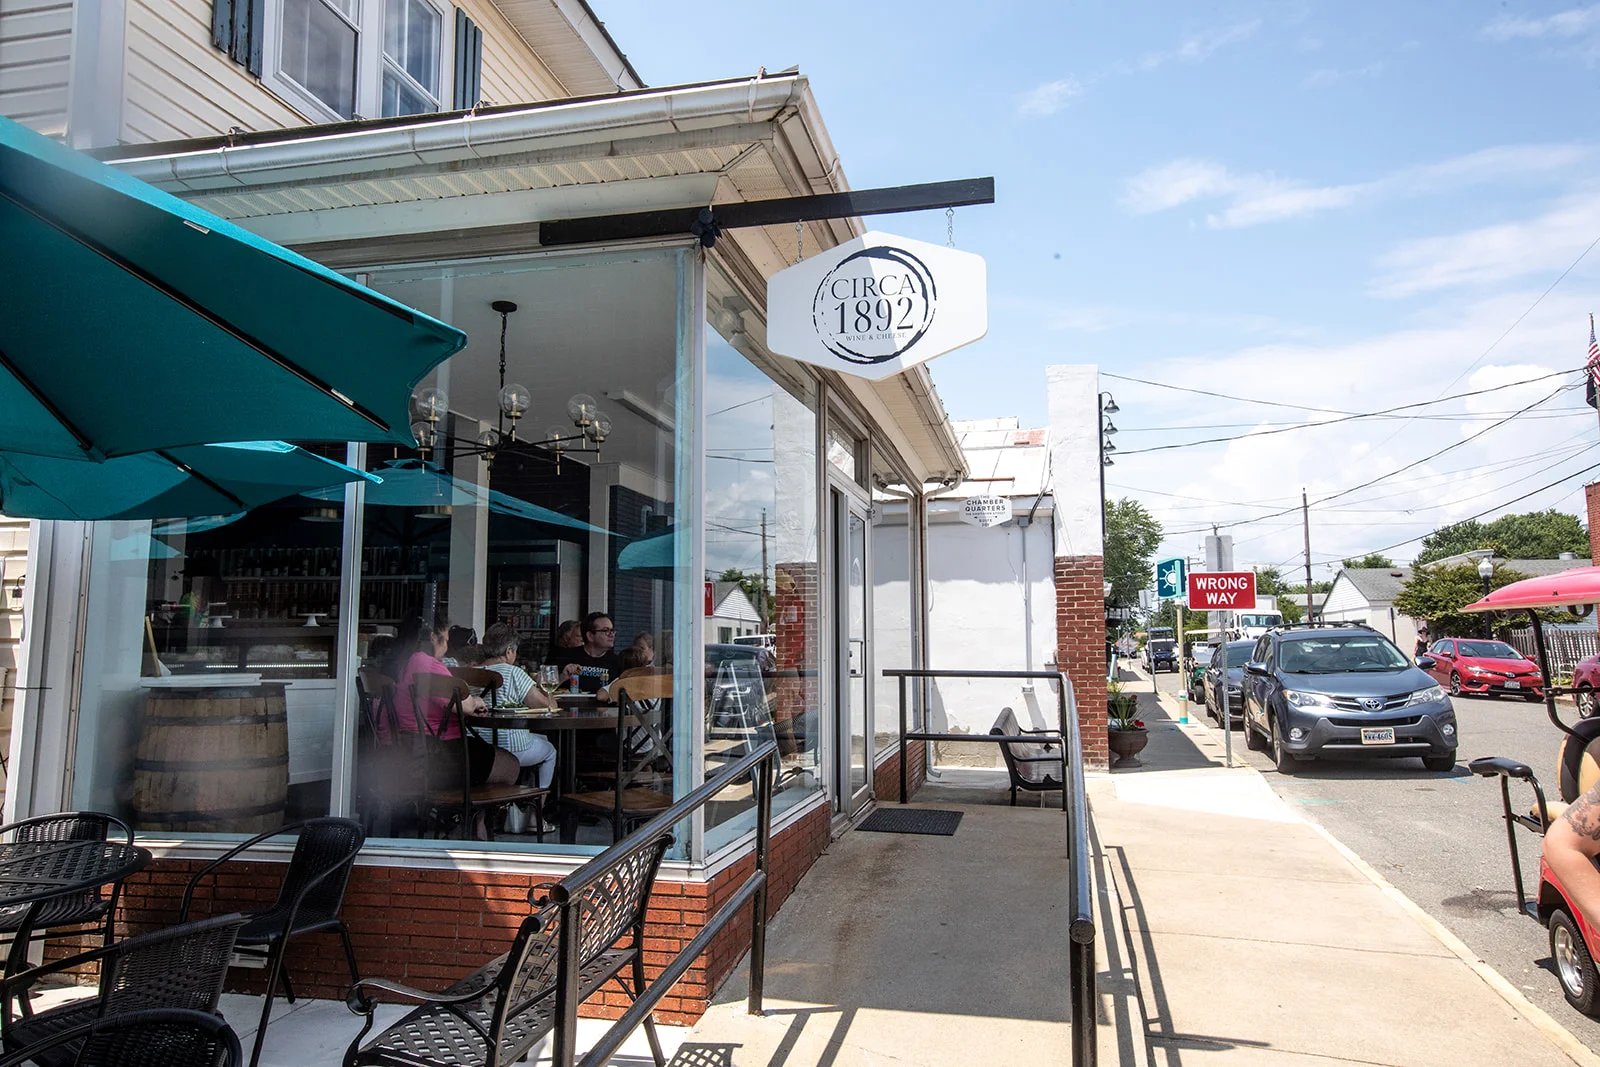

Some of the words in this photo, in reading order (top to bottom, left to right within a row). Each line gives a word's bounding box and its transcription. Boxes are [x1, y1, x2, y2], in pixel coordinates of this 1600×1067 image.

[831, 273, 917, 300] CIRCA
[834, 296, 914, 334] 1892
[876, 332, 907, 340] CHEESE
[966, 498, 1004, 506] CHAMBER
[1196, 577, 1248, 590] WRONG
[1206, 592, 1238, 605] WAY
[581, 666, 609, 674] ROSSFIT
